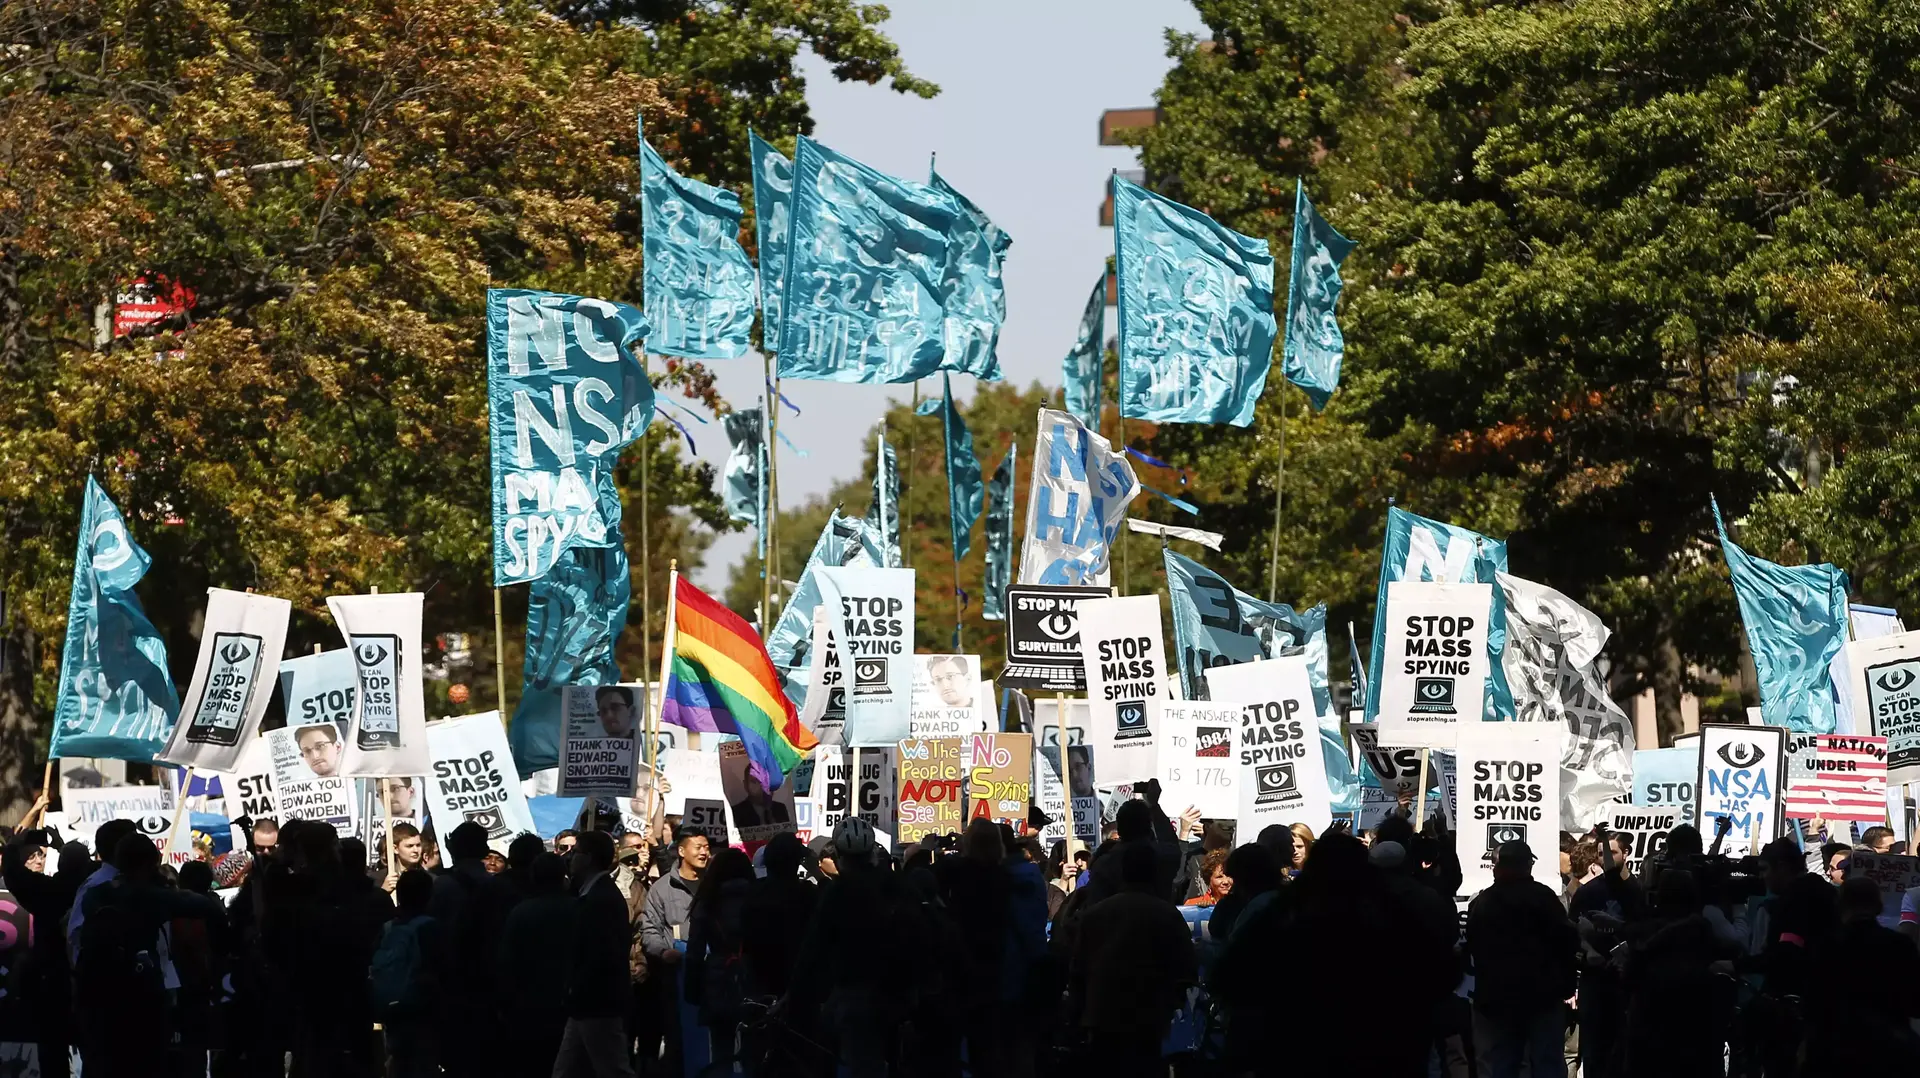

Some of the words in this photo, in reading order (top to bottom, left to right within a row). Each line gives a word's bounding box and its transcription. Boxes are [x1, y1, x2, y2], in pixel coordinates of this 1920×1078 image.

[1018, 598, 1055, 611] STOP
[1406, 615, 1475, 638] STOP
[850, 640, 902, 655] PYING
[1018, 640, 1082, 653] SURVEILLA
[1099, 637, 1152, 661] STOP
[1405, 639, 1472, 658] MASS
[1102, 660, 1155, 682] MASS
[1404, 659, 1471, 676] SPYING
[212, 673, 246, 688] STOP
[362, 677, 390, 690] TOP
[208, 688, 242, 702] MASS
[365, 692, 392, 704] ASS
[1104, 681, 1156, 700] SPYING
[1885, 694, 1896, 702] WE
[1896, 691, 1911, 700] CAN
[204, 701, 237, 713] SPYNG
[364, 705, 392, 716] YING
[911, 710, 941, 719] HANK
[1878, 697, 1920, 716] STOP
[1164, 708, 1186, 720] THE
[1191, 709, 1239, 723] ANSWER
[1406, 715, 1457, 724] stopwatching.us
[911, 721, 960, 733] DWARD
[1241, 721, 1304, 747] MASS
[569, 740, 602, 750] THANK
[1114, 740, 1153, 749] stopwatching.us
[1172, 735, 1187, 748] TO
[1197, 728, 1231, 750] 1984
[900, 738, 929, 759] We
[930, 739, 959, 759] The
[971, 734, 1011, 768] No
[1241, 743, 1306, 766] SPYING
[1789, 736, 1818, 754] ONE
[1828, 737, 1887, 761] NATION
[433, 750, 495, 779] STOP
[568, 751, 618, 764] EDWARD
[1367, 749, 1421, 780] US
[1805, 758, 1857, 772] UNDER
[567, 765, 629, 777] SNOWDEN!
[827, 763, 881, 780] UNPUG
[901, 761, 957, 780] People
[1169, 767, 1181, 781] IS
[1196, 767, 1232, 787] 1776
[1473, 760, 1544, 783] STOP
[280, 782, 313, 797] THANK
[439, 769, 503, 796] MASS
[900, 779, 961, 803] NOT
[970, 767, 1029, 804] Spying
[1707, 768, 1771, 800] NSA
[282, 792, 333, 810] EDWARD
[446, 788, 508, 811] SPYING
[1474, 783, 1543, 803] MASS
[1647, 782, 1697, 803] STO
[900, 801, 935, 823] See
[937, 801, 961, 821] The
[1045, 801, 1068, 810] THAN
[1254, 801, 1304, 814] stopwatching.us
[1473, 805, 1542, 822] SPYING
[1720, 799, 1750, 813] HAS
[1047, 823, 1094, 836] SNODEN!
[1614, 816, 1675, 831] UNPLUG
